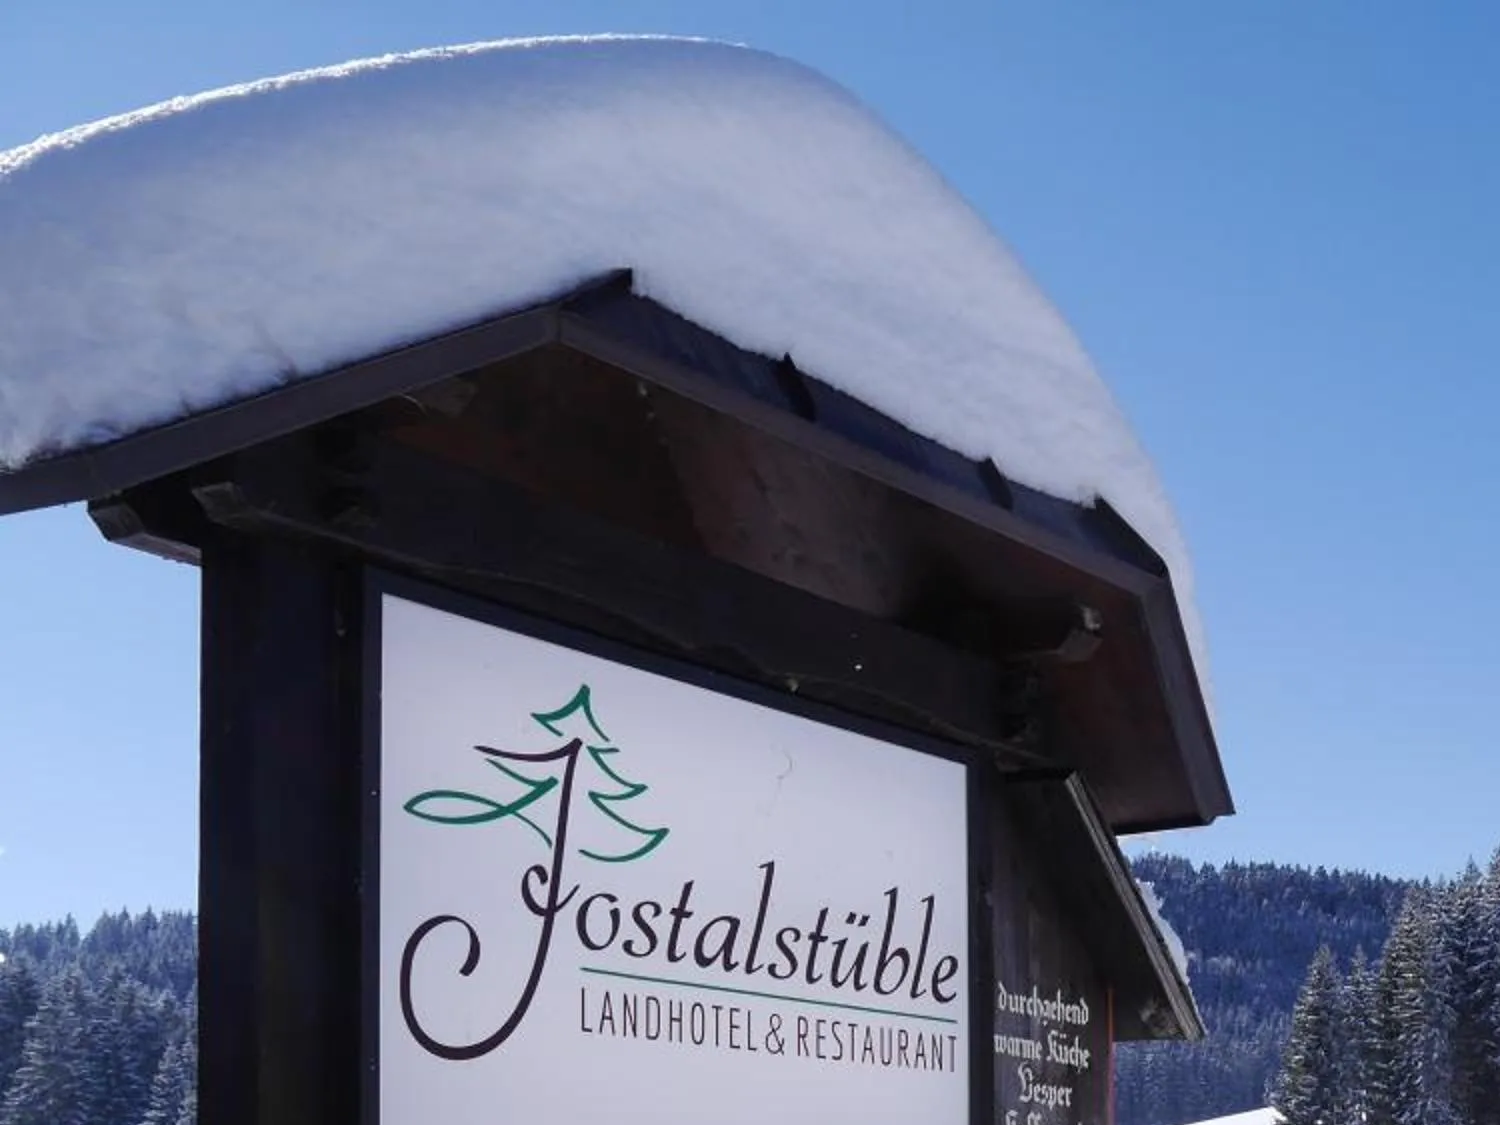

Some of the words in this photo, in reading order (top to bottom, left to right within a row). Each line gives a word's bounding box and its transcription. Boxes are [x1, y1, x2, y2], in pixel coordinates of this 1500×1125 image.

[400, 737, 959, 1060] Jostalstüble
[998, 982, 1089, 1026] durchgehend
[580, 987, 758, 1052] LANDHOTEL
[764, 1013, 786, 1055] &
[796, 1015, 957, 1073] RESTAURANT
[994, 1034, 1043, 1060] warme
[1046, 1030, 1090, 1072] Küche
[1018, 1062, 1072, 1109] Vesper
